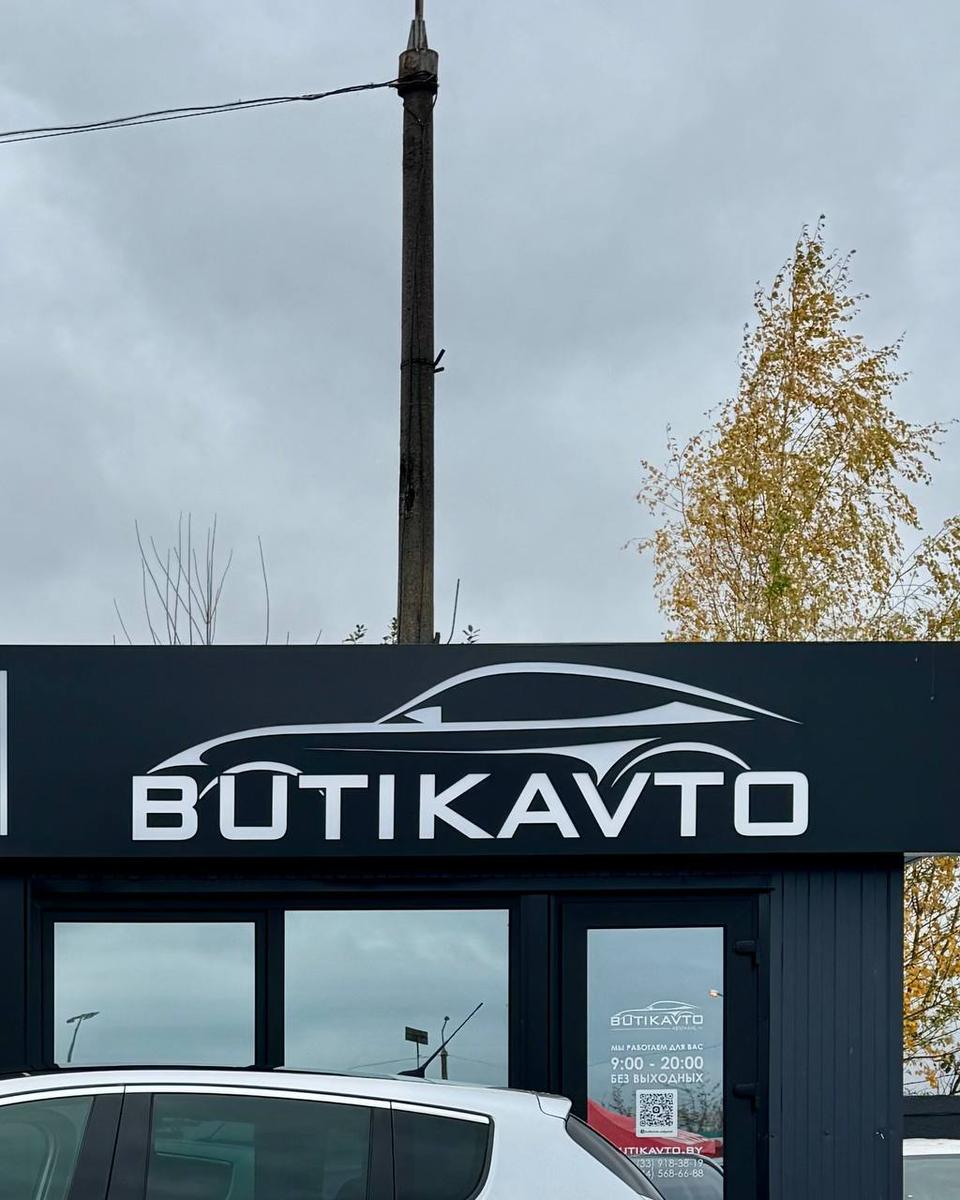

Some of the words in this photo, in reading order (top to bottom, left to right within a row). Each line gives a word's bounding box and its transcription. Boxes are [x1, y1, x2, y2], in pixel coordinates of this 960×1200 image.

[132, 770, 810, 841] BUTIKAVTO
[610, 1015, 704, 1026] BUTIKAVTO
[611, 1056, 644, 1070] 9:00
[660, 1056, 704, 1070] 20:00
[611, 1074, 629, 1084] БЕЗ
[633, 1073, 704, 1084] ВЫХОДНЫХ
[619, 1146, 704, 1155] UTIKAVTO.BY
[657, 1158, 704, 1168] 918-38-19
[657, 1169, 704, 1178] 568-66-88
